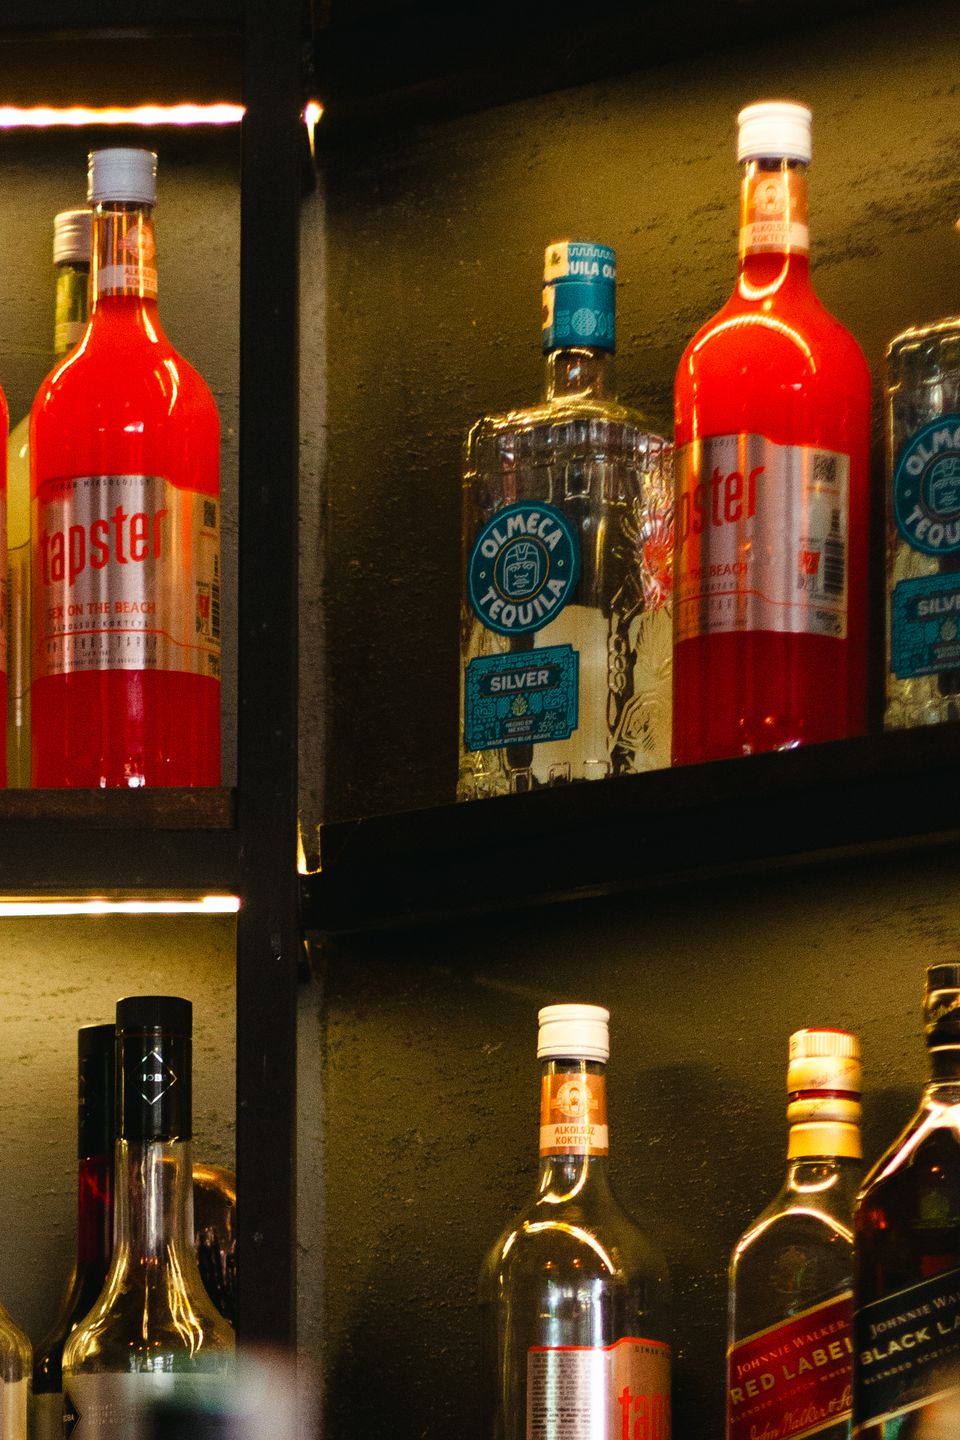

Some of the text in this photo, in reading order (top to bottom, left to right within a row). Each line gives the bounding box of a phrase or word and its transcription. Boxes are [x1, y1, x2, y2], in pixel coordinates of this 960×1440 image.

[676, 466, 766, 548] pster
[40, 504, 169, 589] tapster
[481, 512, 563, 559] OLMECA
[709, 563, 748, 577] BEACH
[68, 603, 84, 616] ON
[89, 602, 110, 614] THE
[115, 601, 156, 615] BEACH
[479, 578, 566, 628] TEQUILA
[490, 669, 549, 692] SILVER
[870, 1304, 932, 1340] JOHNNIE
[860, 1315, 960, 1366] BLACK LA
[736, 1345, 790, 1379] JOHNNIE
[730, 1373, 776, 1405] RED
